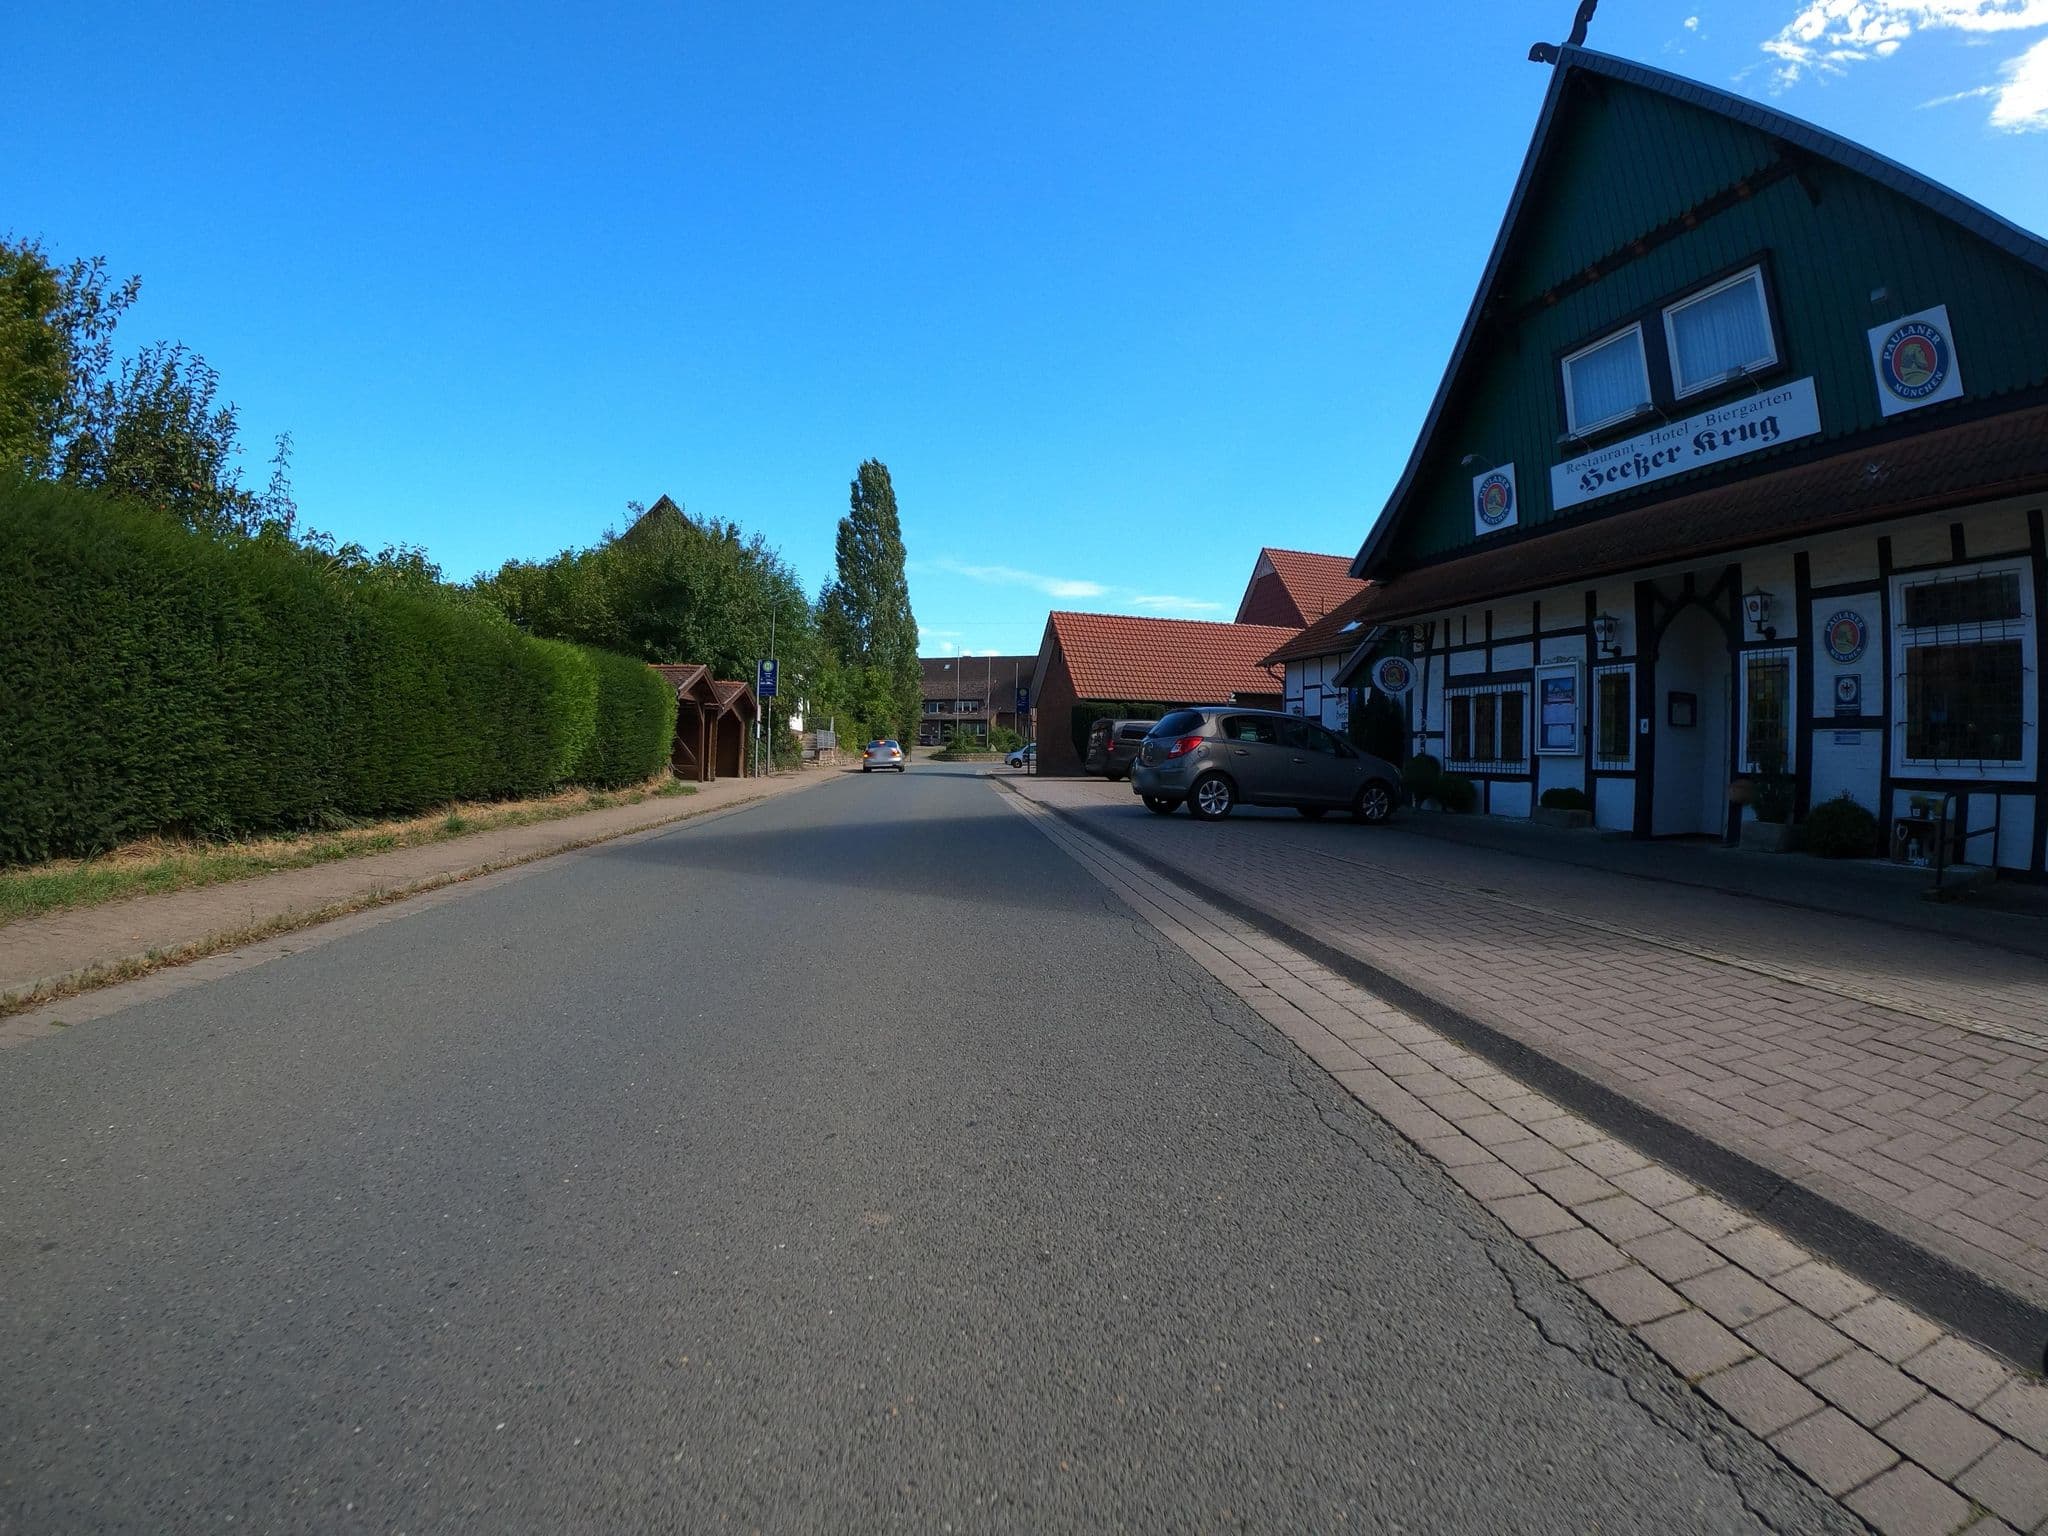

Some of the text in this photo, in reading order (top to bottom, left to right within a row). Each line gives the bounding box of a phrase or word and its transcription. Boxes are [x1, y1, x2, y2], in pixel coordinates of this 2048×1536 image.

[1884, 325, 1940, 360] PAULANER
[1894, 371, 1944, 397] MÜNCHEN
[1566, 442, 1636, 475] Restaurant
[1650, 423, 1690, 446] Hotel
[1705, 390, 1793, 428] Biergarten
[1692, 414, 1781, 457] Krug
[1827, 612, 1863, 632] PAULANER
